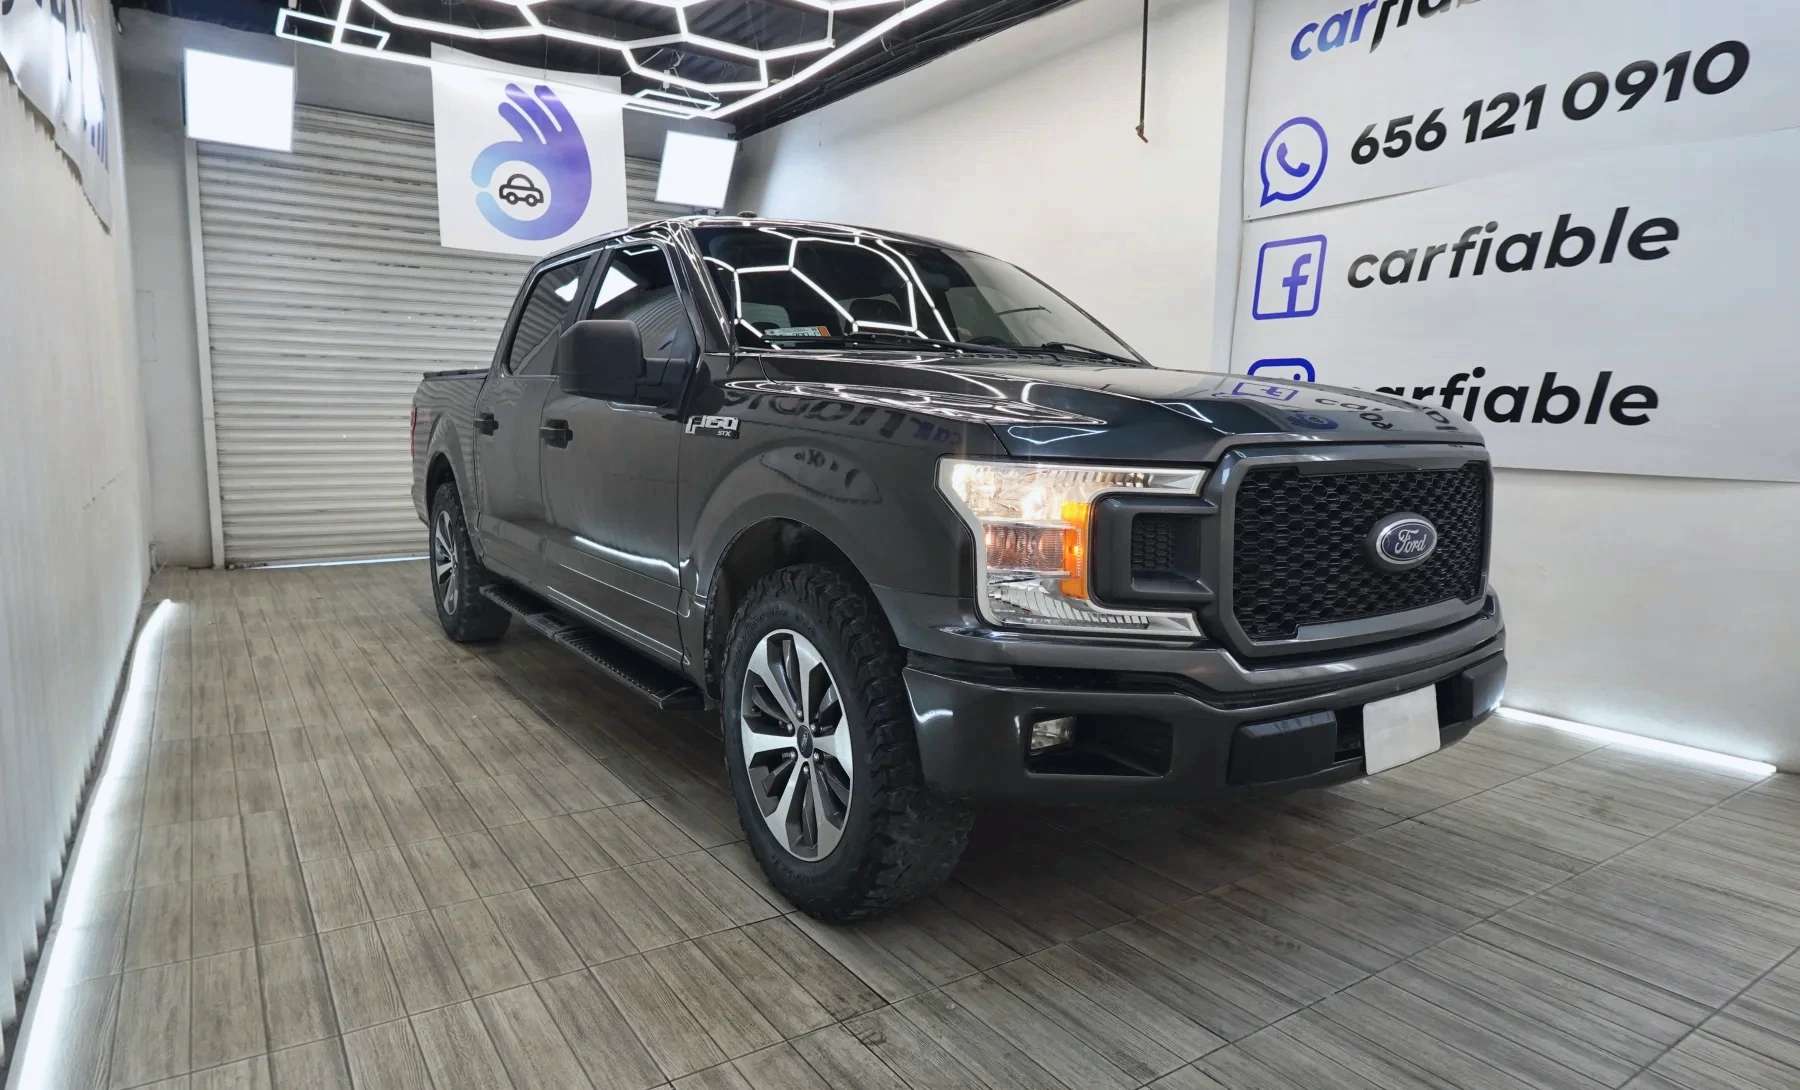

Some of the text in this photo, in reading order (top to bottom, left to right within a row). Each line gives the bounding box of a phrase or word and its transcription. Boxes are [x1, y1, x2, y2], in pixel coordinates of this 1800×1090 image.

[1350, 40, 1751, 165] 656 121 0910
[1347, 206, 1679, 288] carfiable
[1352, 366, 1659, 426] rfiable
[1394, 529, 1427, 554] Ford
